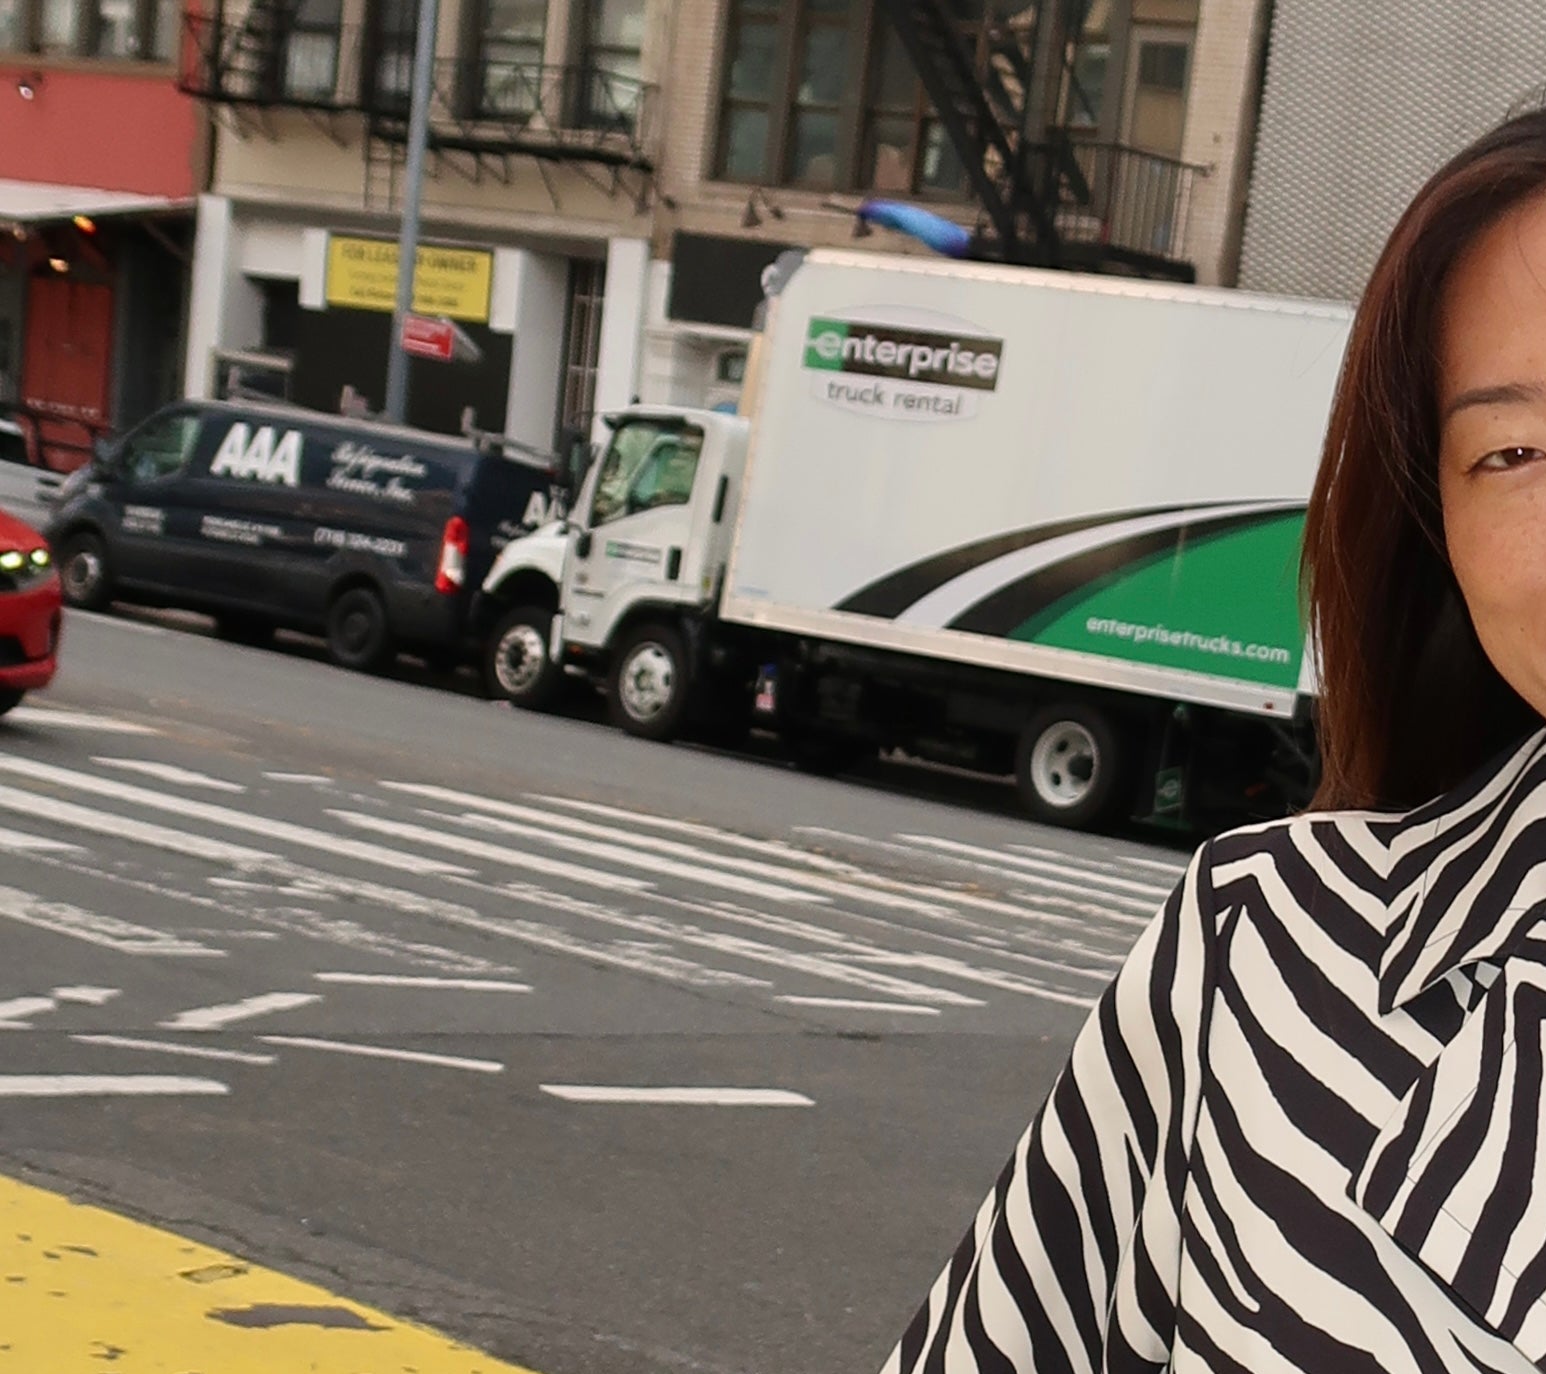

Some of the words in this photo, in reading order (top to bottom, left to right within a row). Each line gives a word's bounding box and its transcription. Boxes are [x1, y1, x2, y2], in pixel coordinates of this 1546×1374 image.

[806, 330, 998, 379] enterprise
[827, 381, 884, 406] truck
[893, 390, 962, 415] rental
[209, 422, 302, 488] AAA
[1086, 617, 1290, 663] enterprisetrucks.com
